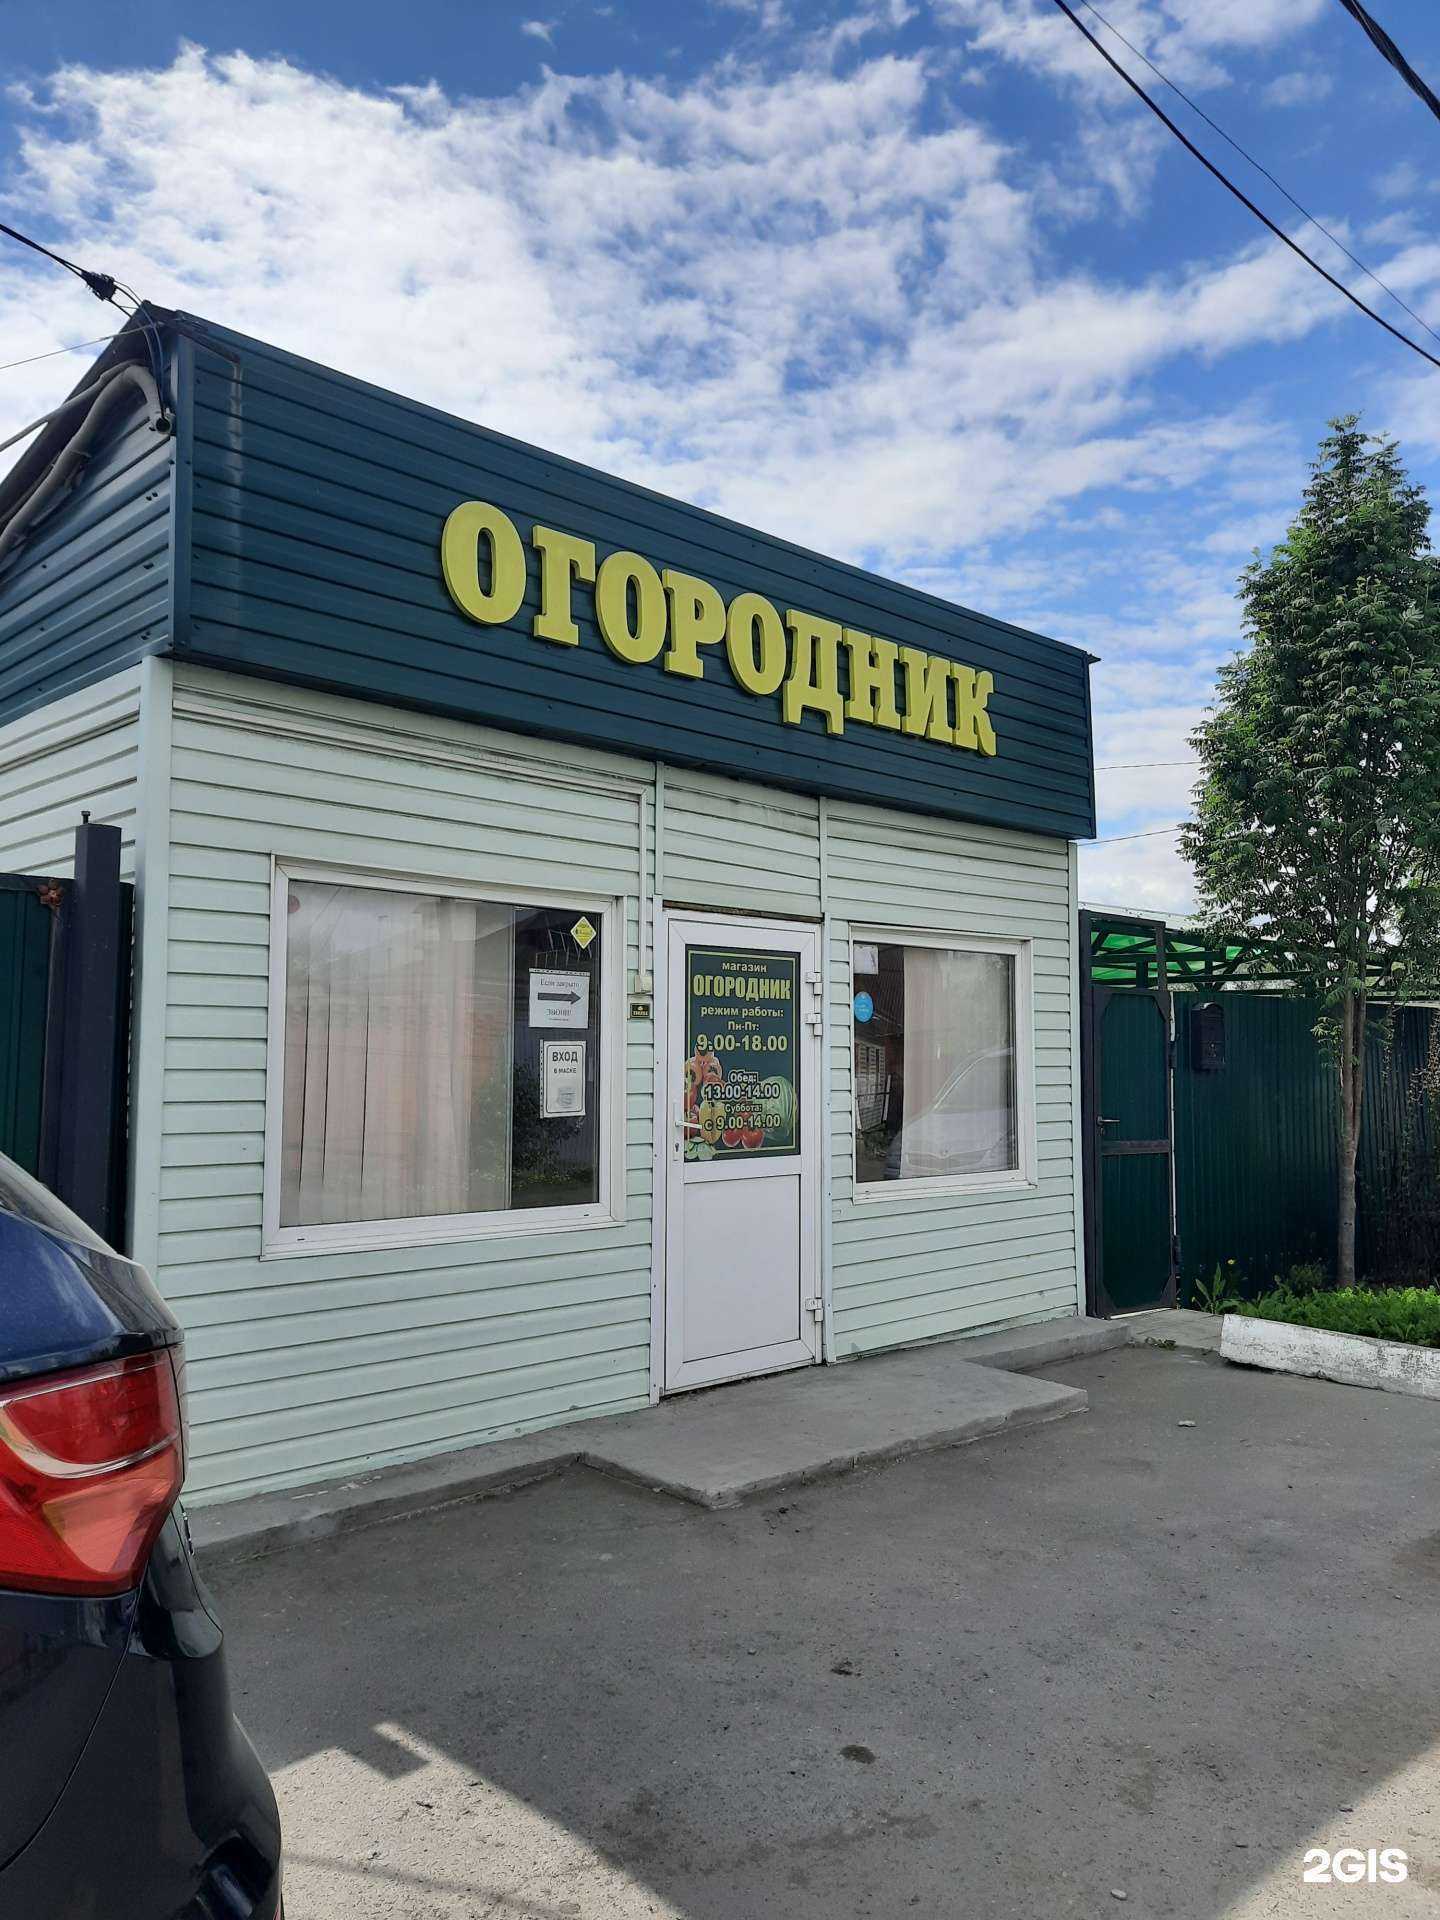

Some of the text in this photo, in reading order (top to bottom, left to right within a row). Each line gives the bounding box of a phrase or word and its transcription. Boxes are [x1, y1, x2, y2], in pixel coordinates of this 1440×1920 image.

[441, 500, 997, 757] ОГОРОДНИК
[722, 962, 767, 973] магазин
[693, 974, 791, 1001] ОГОРОДНИК
[701, 1006, 784, 1018] режим работы:
[728, 1021, 760, 1031] Пн-Пт:
[552, 1051, 578, 1063] ВХОД
[730, 1072, 757, 1084] Обед:
[725, 1104, 762, 1113] Суббота:
